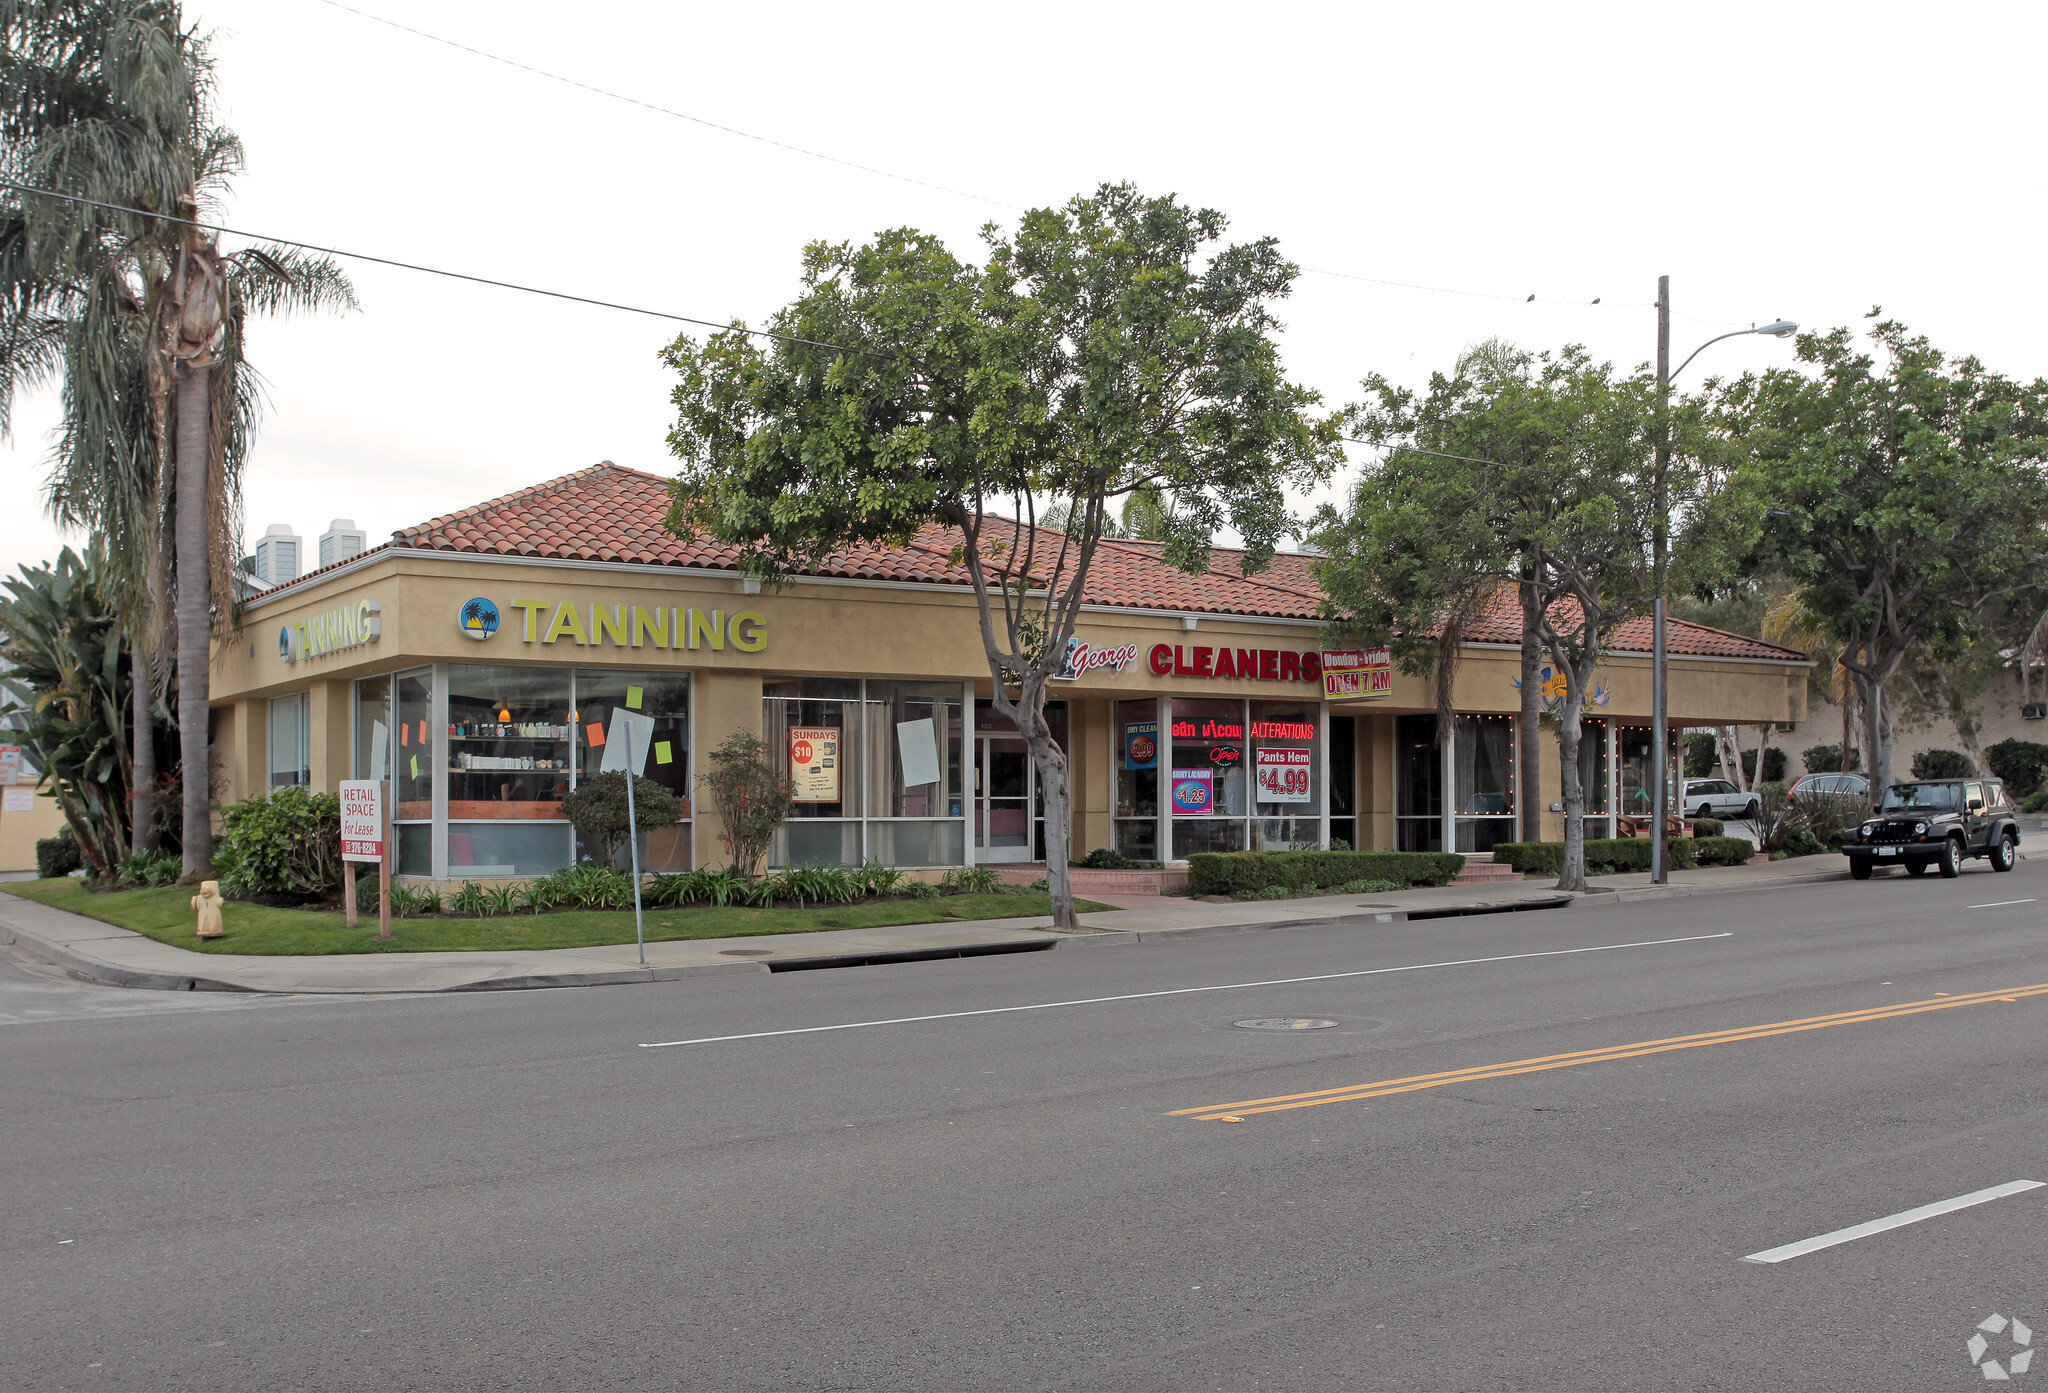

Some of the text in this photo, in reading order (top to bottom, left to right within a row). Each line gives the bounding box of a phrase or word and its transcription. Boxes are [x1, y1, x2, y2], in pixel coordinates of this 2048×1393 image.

[293, 599, 379, 661] TANNING
[510, 599, 768, 652] TANNING
[1072, 642, 1139, 677] George
[1147, 643, 1321, 682] CLEANERS
[1324, 653, 1359, 667] Monday
[1364, 651, 1390, 665] Friday
[1326, 669, 1391, 695] OPEN 7 AM
[793, 731, 837, 740] SUNDAYS
[1127, 726, 1138, 734] DRY
[1250, 722, 1315, 740] ALTERATIONS
[794, 746, 811, 758] $10
[1209, 747, 1240, 762] Open
[1258, 751, 1309, 763] Pants Hem
[1172, 770, 1212, 779] SHIRT LAUNDRY
[1259, 768, 1310, 795] $4.99
[344, 789, 376, 801] RETAIL
[1177, 788, 1206, 804] $1.25
[346, 803, 375, 816] SPACE
[344, 820, 374, 836] For Lease
